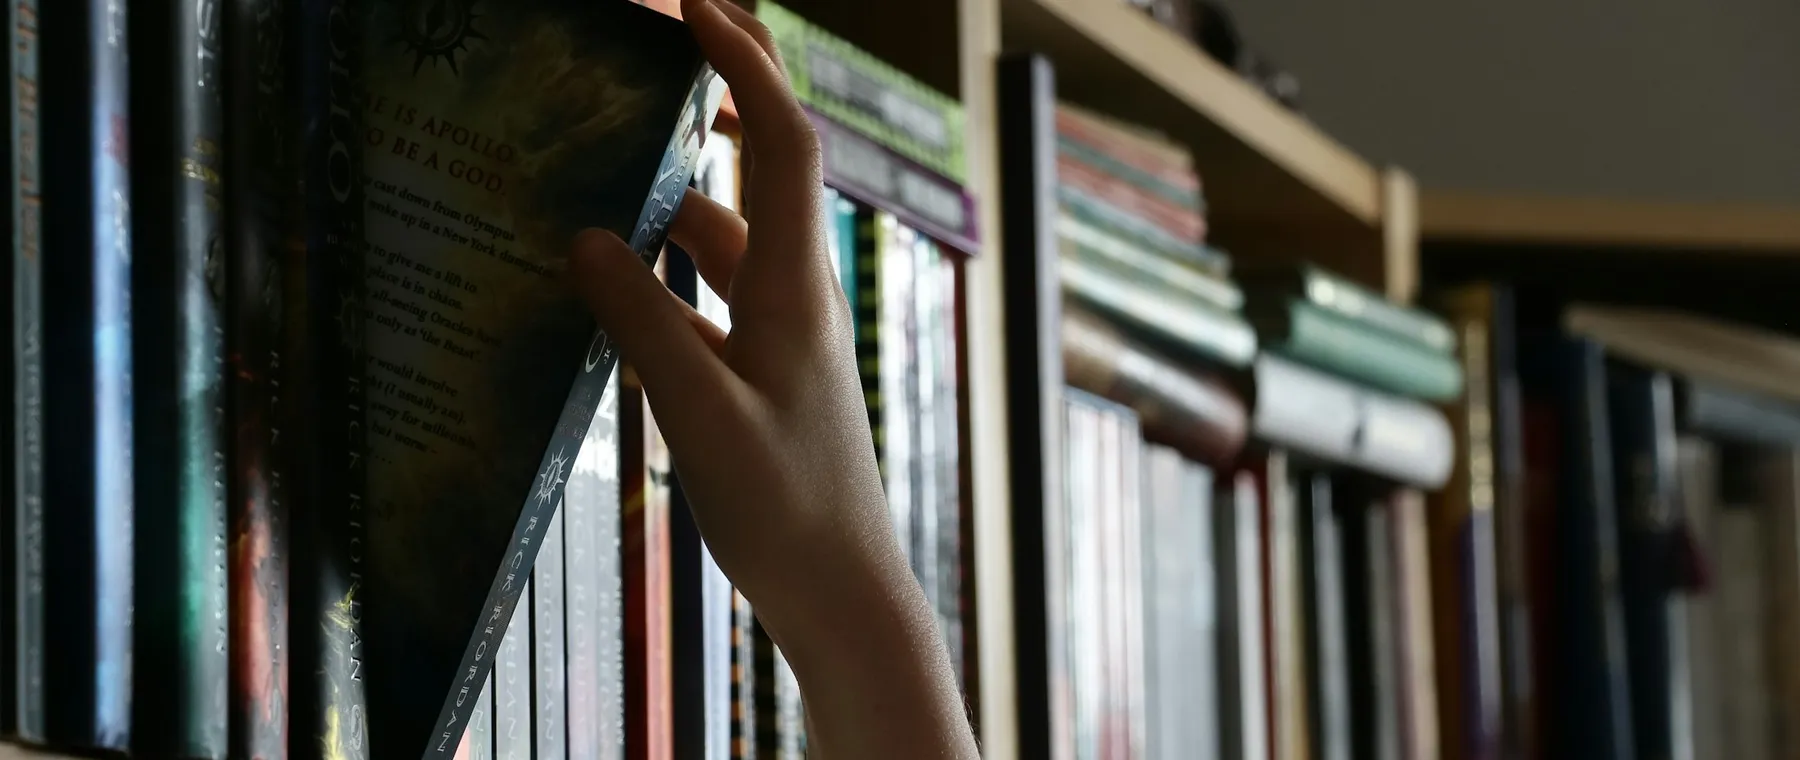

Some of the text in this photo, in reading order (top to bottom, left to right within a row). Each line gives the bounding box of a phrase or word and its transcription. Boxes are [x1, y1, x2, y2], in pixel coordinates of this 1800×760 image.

[394, 103, 417, 126] IS
[421, 116, 514, 163] APOLLO
[392, 137, 420, 161] BE
[423, 151, 439, 171] A
[449, 159, 506, 196] GOD.
[671, 151, 692, 191] THE
[374, 179, 397, 196] cast
[398, 188, 431, 208] down
[433, 201, 461, 221] from
[464, 214, 515, 242] Olympus
[401, 213, 416, 229] up
[419, 216, 431, 230] in
[433, 226, 440, 235] a
[443, 226, 469, 245] New
[471, 237, 496, 258] York
[374, 244, 386, 258] to
[389, 252, 412, 268] give
[415, 262, 431, 276] me
[434, 271, 441, 280] a
[444, 271, 461, 288] lift
[465, 279, 477, 294] to
[402, 277, 412, 290] is
[414, 282, 425, 295] in
[376, 313, 401, 333] only
[404, 326, 417, 337] as
[431, 312, 474, 337] Oracles
[377, 358, 413, 380] would
[416, 371, 458, 398] involve
[399, 387, 438, 415] usually
[401, 410, 421, 427] for
[348, 375, 363, 682] RICK RIORDAN
[437, 515, 539, 753] RICK RIORDAN
[542, 571, 555, 741] RIORDAN
